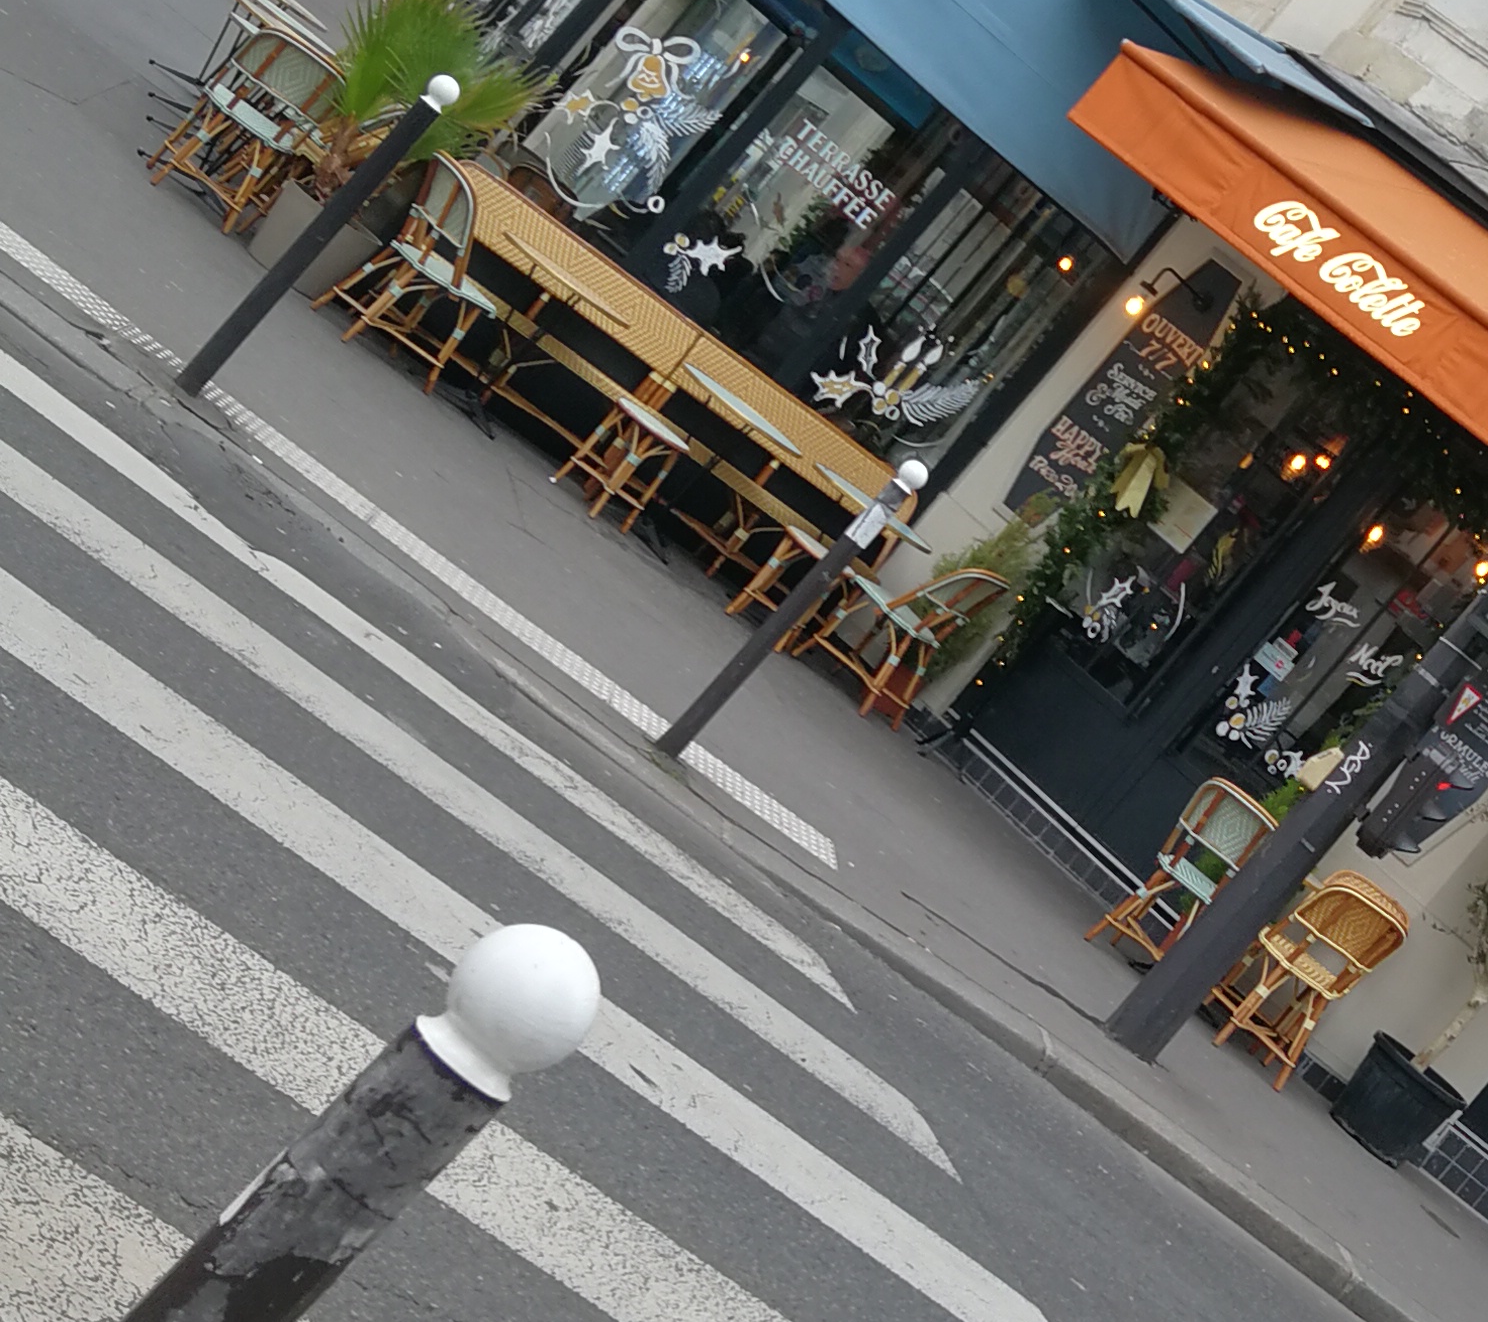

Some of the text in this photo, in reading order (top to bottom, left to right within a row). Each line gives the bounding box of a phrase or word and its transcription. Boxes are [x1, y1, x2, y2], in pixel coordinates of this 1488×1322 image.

[777, 136, 879, 231] CHAUFFÉE
[796, 118, 897, 211] TERRASSE
[1317, 252, 1426, 336] Colette
[1140, 340, 1178, 372] 7/7
[1141, 313, 1205, 367] OUVERT
[1051, 415, 1102, 462] HAPPY
